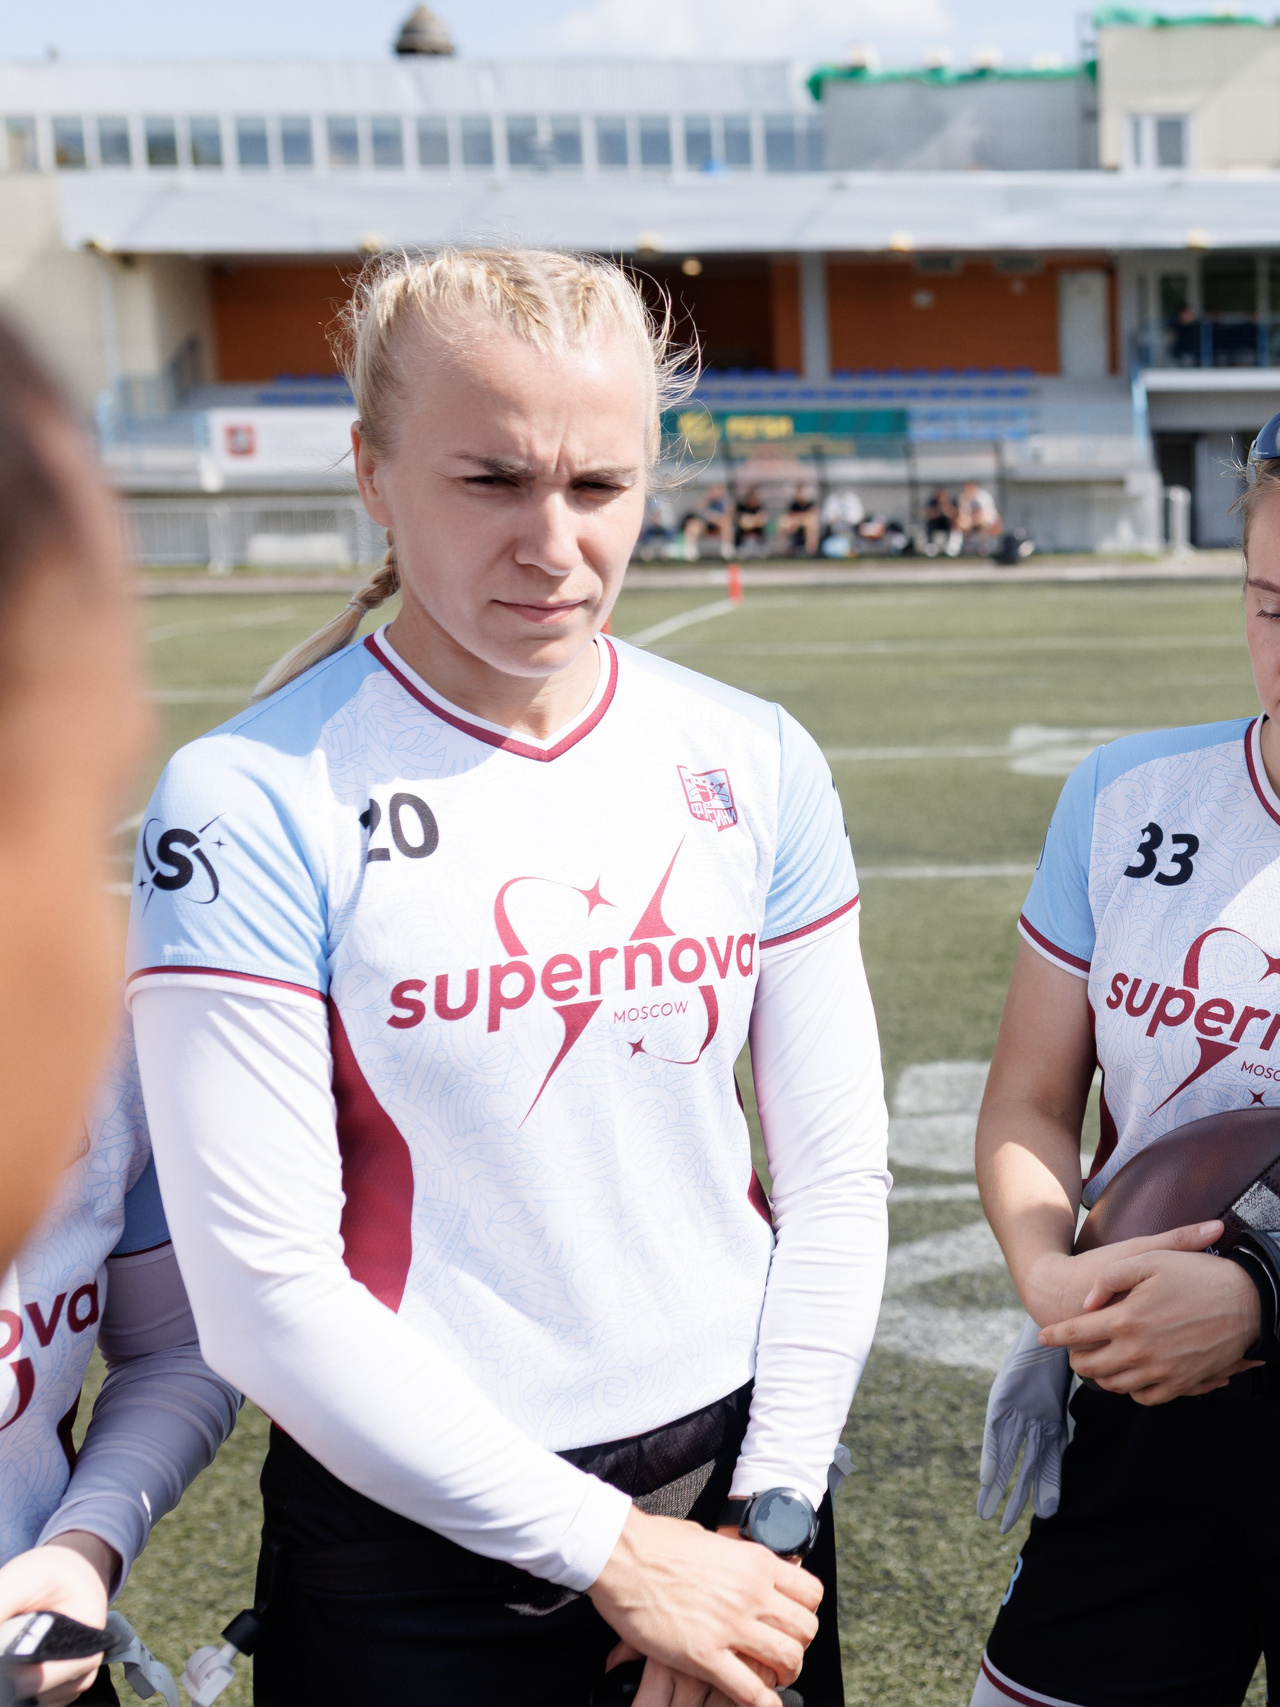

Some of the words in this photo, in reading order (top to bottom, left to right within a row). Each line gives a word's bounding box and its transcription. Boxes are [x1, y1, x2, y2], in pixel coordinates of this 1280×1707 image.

[151, 828, 201, 891] S
[358, 792, 440, 864] 20
[1123, 822, 1200, 886] 33
[386, 932, 757, 1034] supernova
[613, 1000, 690, 1025] MOSCOW
